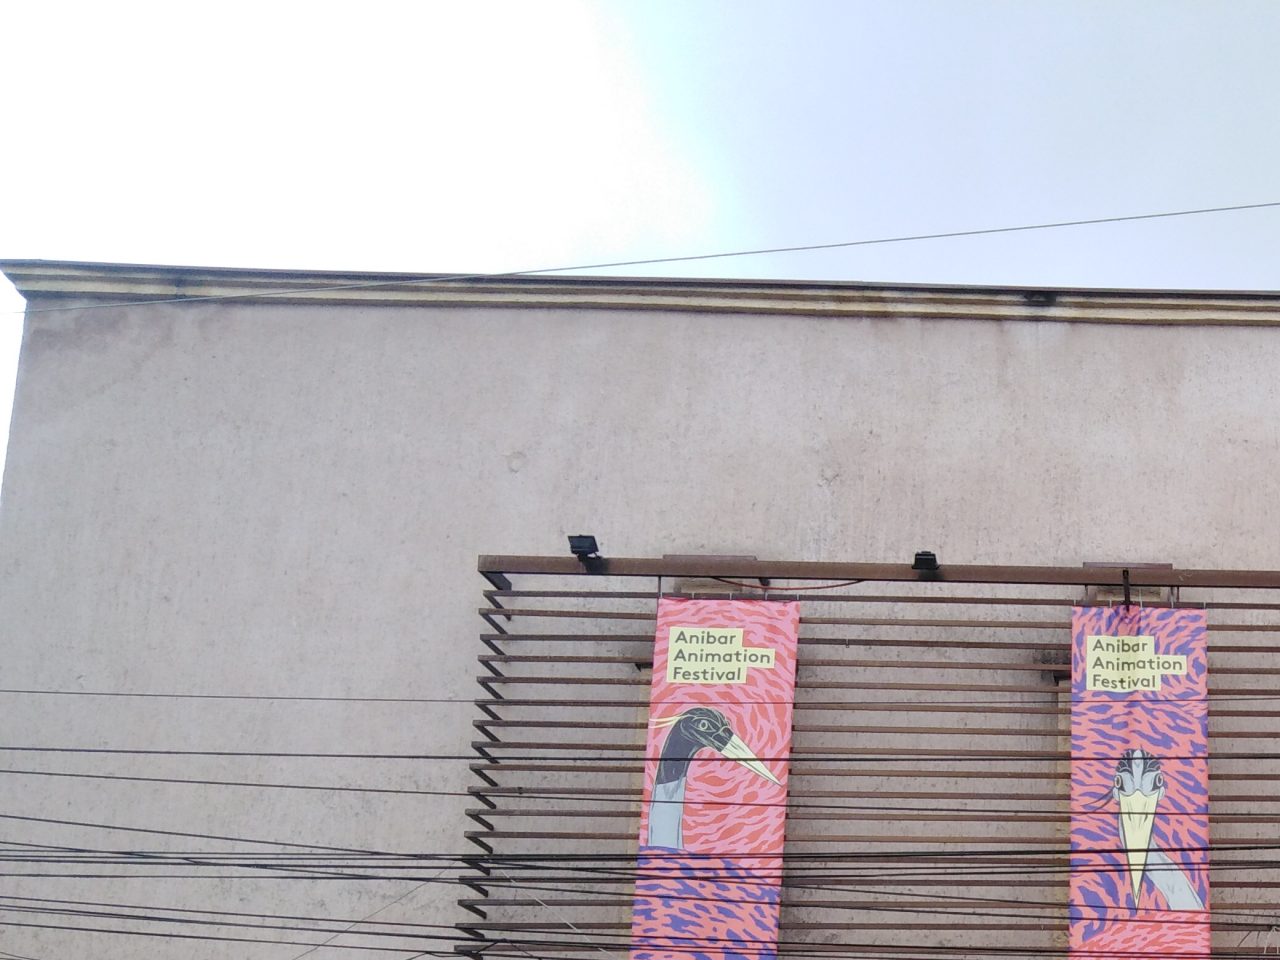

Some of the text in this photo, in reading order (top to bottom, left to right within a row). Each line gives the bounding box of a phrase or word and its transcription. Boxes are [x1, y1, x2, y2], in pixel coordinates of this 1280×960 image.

[675, 630, 736, 645] Anibar
[1092, 639, 1148, 653] Anibar
[673, 648, 771, 664] Animation
[1092, 656, 1183, 671] Animation
[673, 666, 741, 681] Festival
[1092, 674, 1156, 690] Festival
